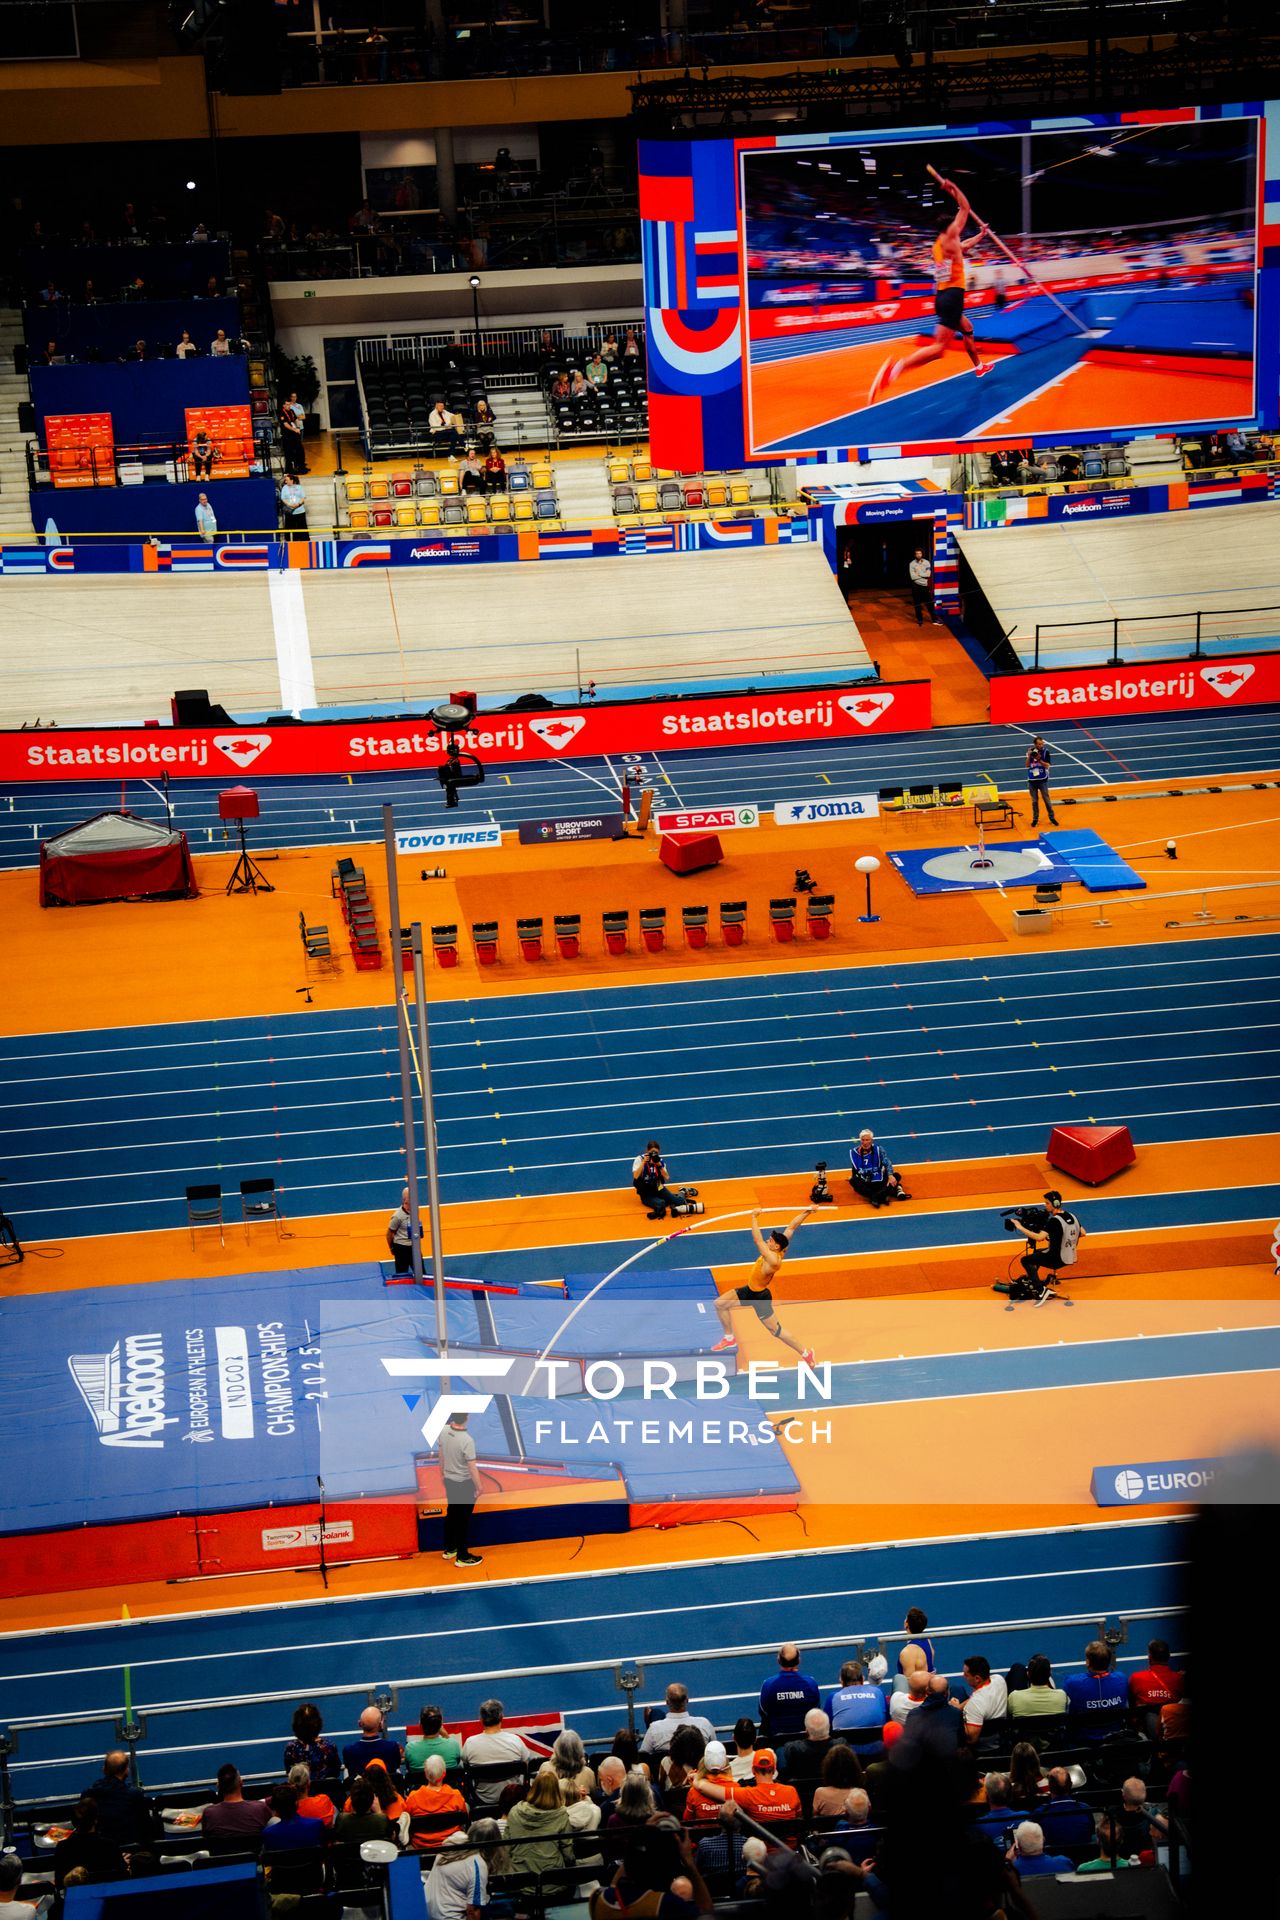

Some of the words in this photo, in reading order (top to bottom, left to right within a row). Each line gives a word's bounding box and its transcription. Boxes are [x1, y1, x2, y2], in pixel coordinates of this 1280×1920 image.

[885, 508, 904, 516] People
[1027, 672, 1195, 707] Staatsloterij
[662, 700, 833, 735] Staatsloterij
[350, 724, 525, 757] Staatsloterij
[27, 739, 208, 766] Staatsloterij
[554, 819, 603, 831] EUROVISION
[675, 812, 735, 828] SPAR
[397, 833, 445, 849] TOYO
[447, 829, 499, 844] TIRES
[555, 827, 582, 836] SPORT
[185, 1328, 207, 1376] ATHLETICS
[256, 1321, 296, 1436] CHAMPIONSHIPS
[298, 1346, 328, 1401] 2025
[99, 1332, 180, 1448] Apeldoorn
[188, 1377, 209, 1428] EUROPEAN
[1146, 1471, 1216, 1491] EUROH
[777, 1690, 805, 1701] ESTONIA
[840, 1692, 876, 1701] ESTONIA
[1086, 1696, 1122, 1709] ESTONIA
[758, 1803, 792, 1812] TeamNL
